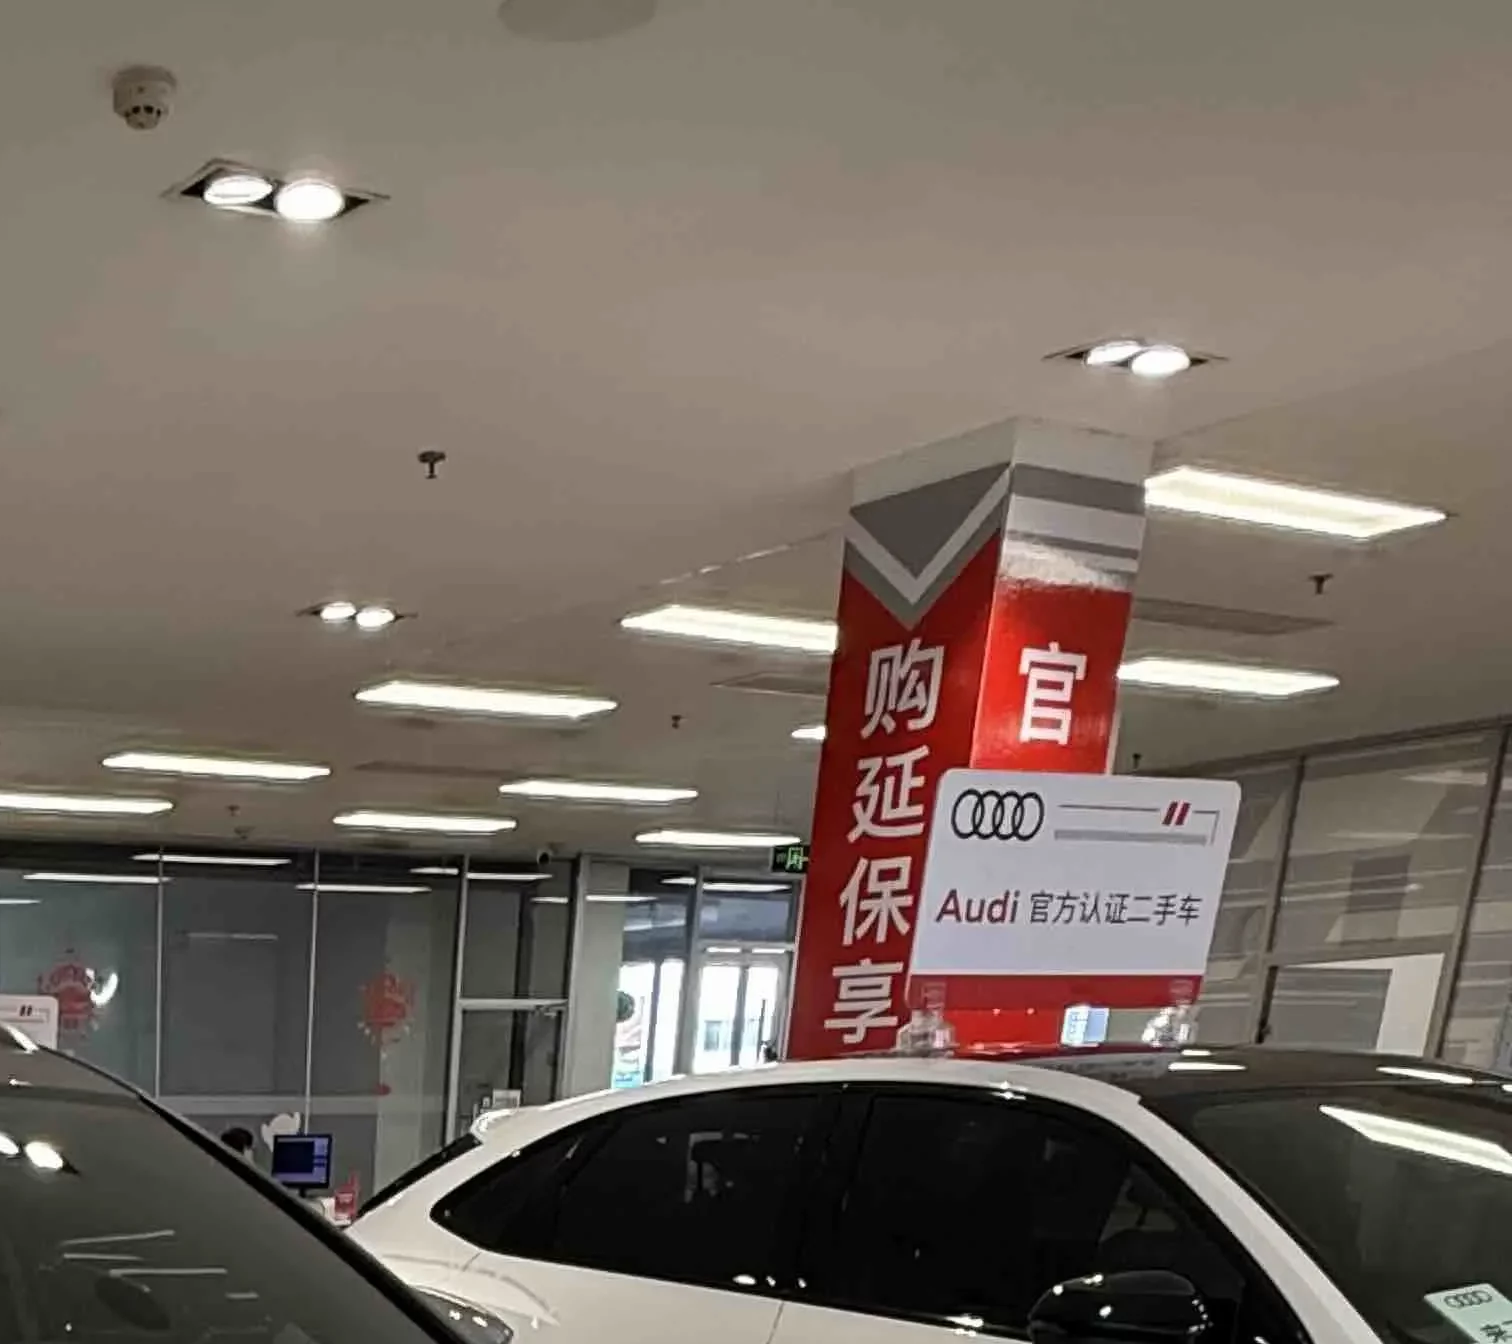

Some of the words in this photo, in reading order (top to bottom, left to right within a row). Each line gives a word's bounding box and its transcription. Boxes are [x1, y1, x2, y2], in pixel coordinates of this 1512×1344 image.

[1018, 642, 1088, 747] 官
[824, 638, 945, 1044] 购延保享
[935, 888, 1020, 925] Audi
[1029, 890, 1201, 928] 官方认证二手车
